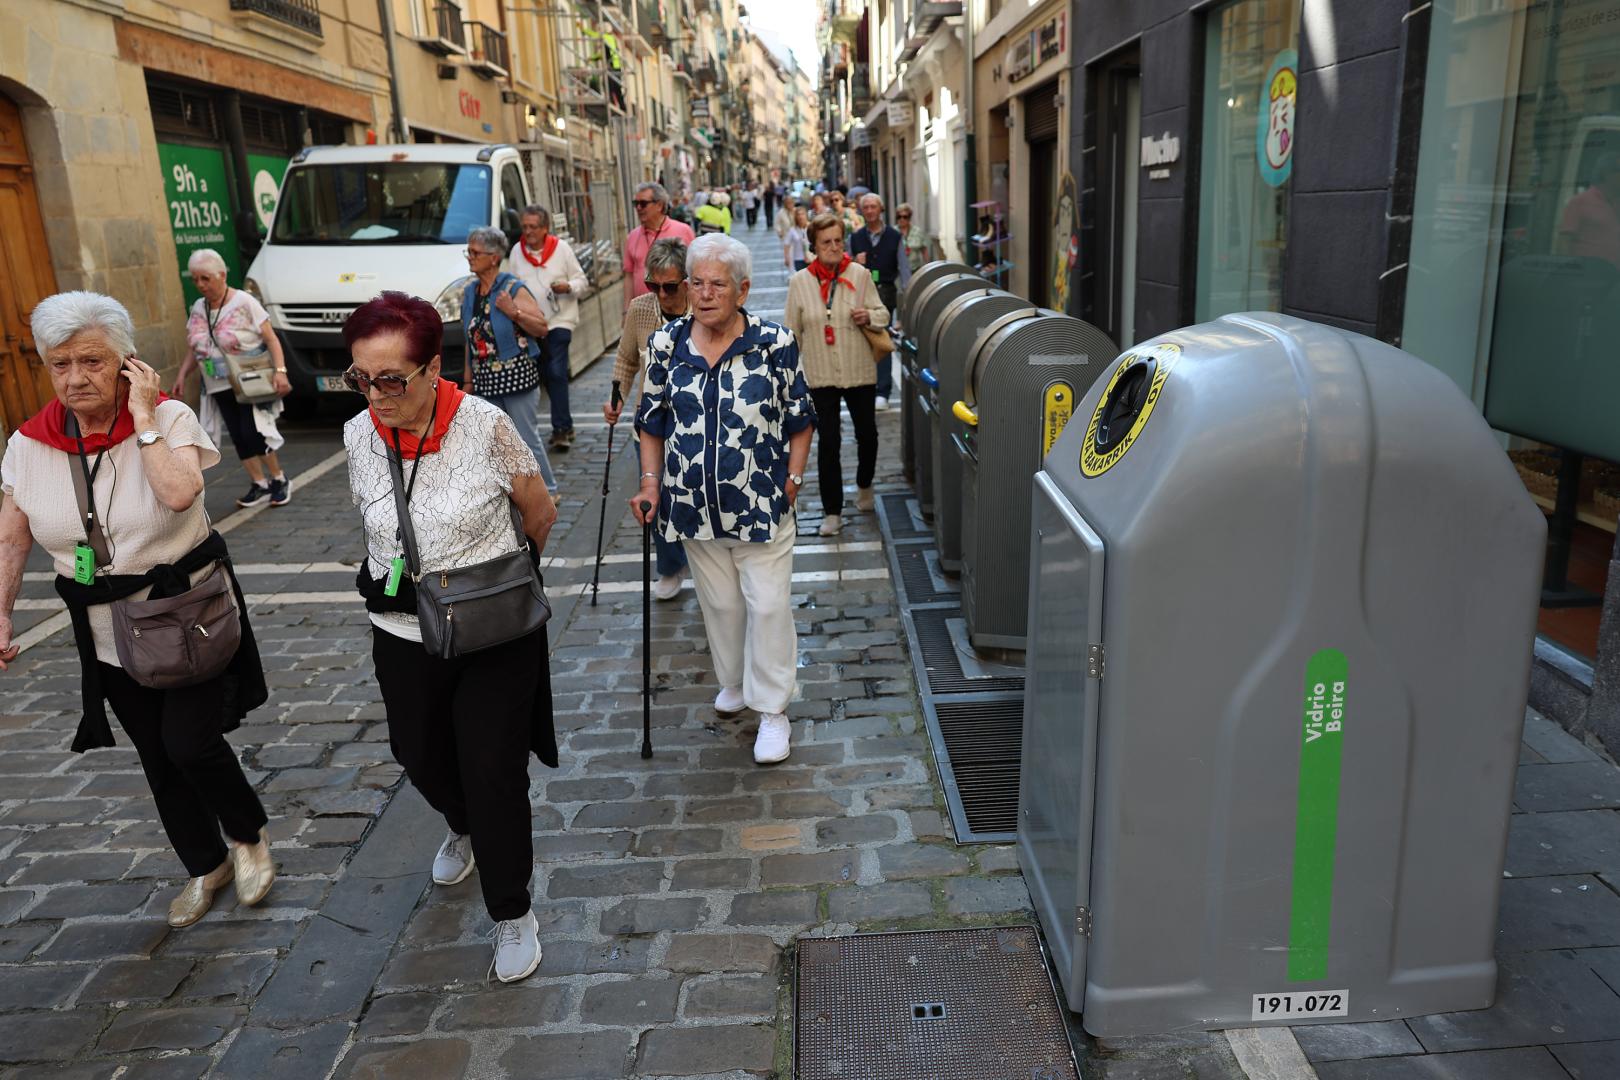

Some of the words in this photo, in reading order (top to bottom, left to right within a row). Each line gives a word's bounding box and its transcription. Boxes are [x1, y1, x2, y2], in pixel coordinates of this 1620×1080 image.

[173, 164, 198, 193] 9h
[200, 178, 208, 193] a
[170, 200, 221, 229] 21h30
[1085, 432, 1133, 472] BAKARRIK
[1306, 683, 1325, 743] Vidrio
[1325, 681, 1345, 732] Beira
[1258, 995, 1342, 1014] 191.072
